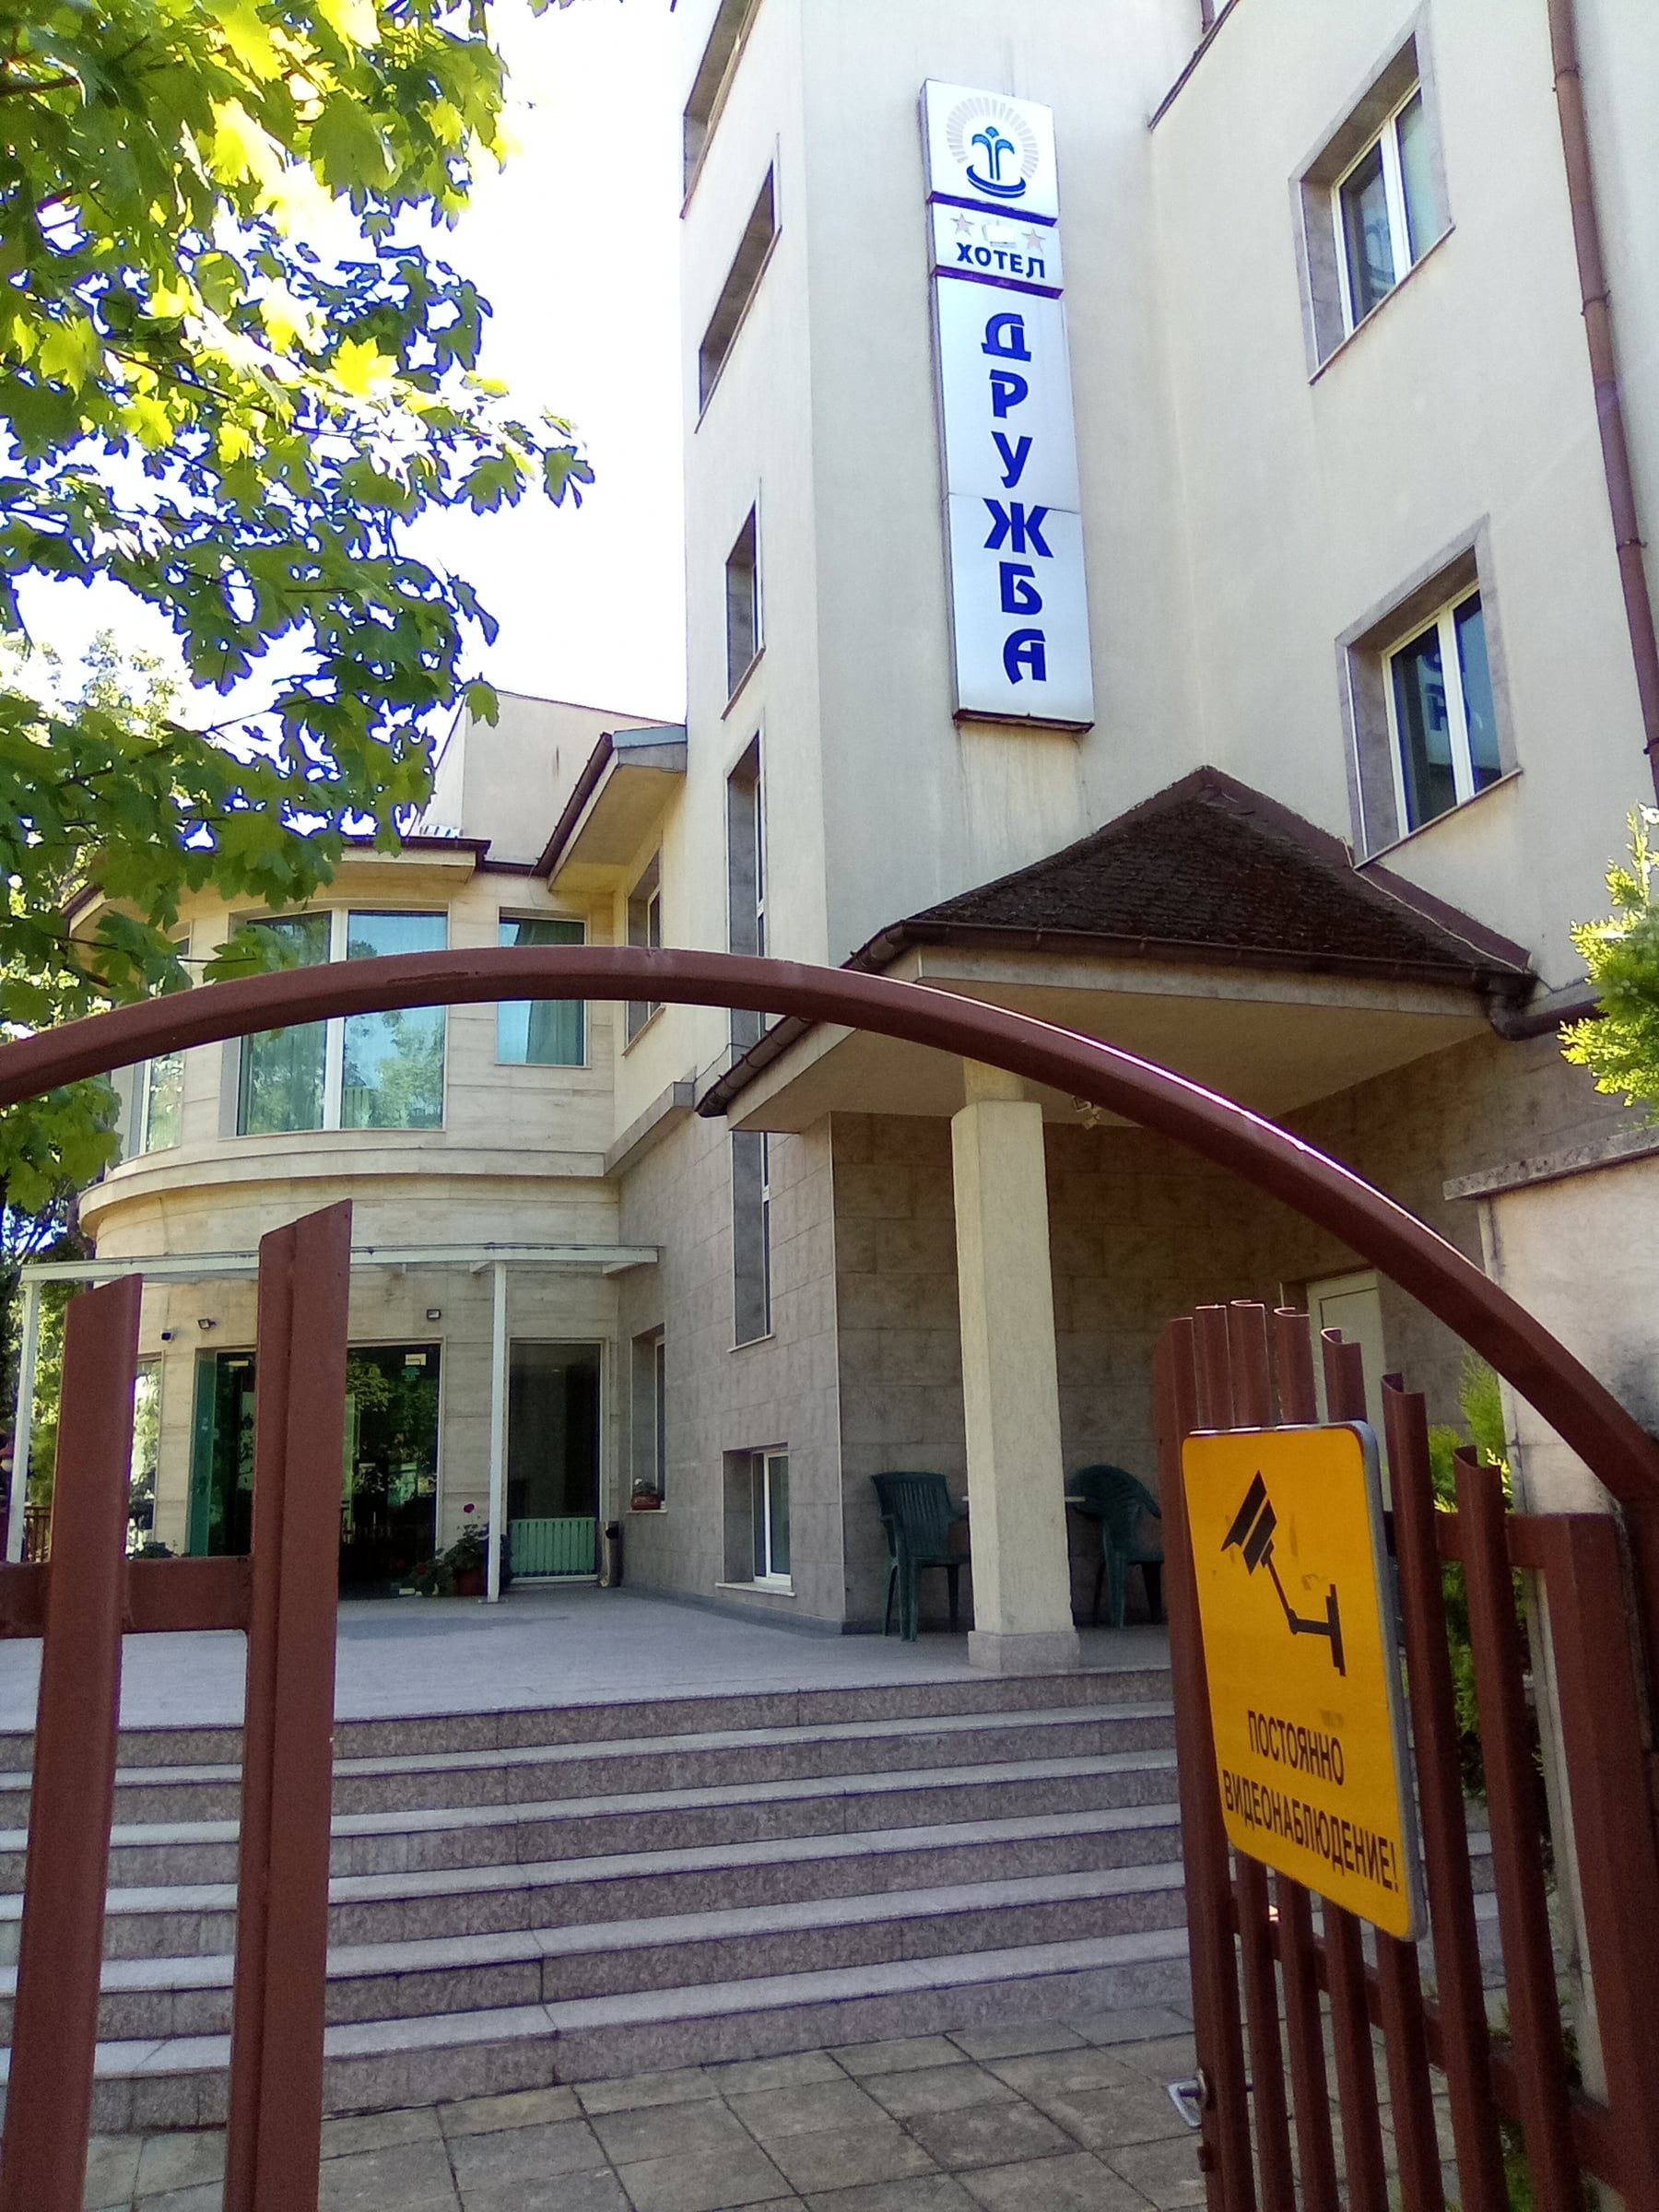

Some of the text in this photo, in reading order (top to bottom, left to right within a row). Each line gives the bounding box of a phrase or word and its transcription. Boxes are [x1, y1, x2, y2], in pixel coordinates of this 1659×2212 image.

[956, 241, 1045, 279] ХОТЕЛ
[981, 312, 1054, 686] ДРУЖБА
[1247, 1710, 1345, 1786] ПОСТОЯННО
[1222, 1769, 1398, 1893] ВИДЕОНАБЛЮДЕНИЕ!
